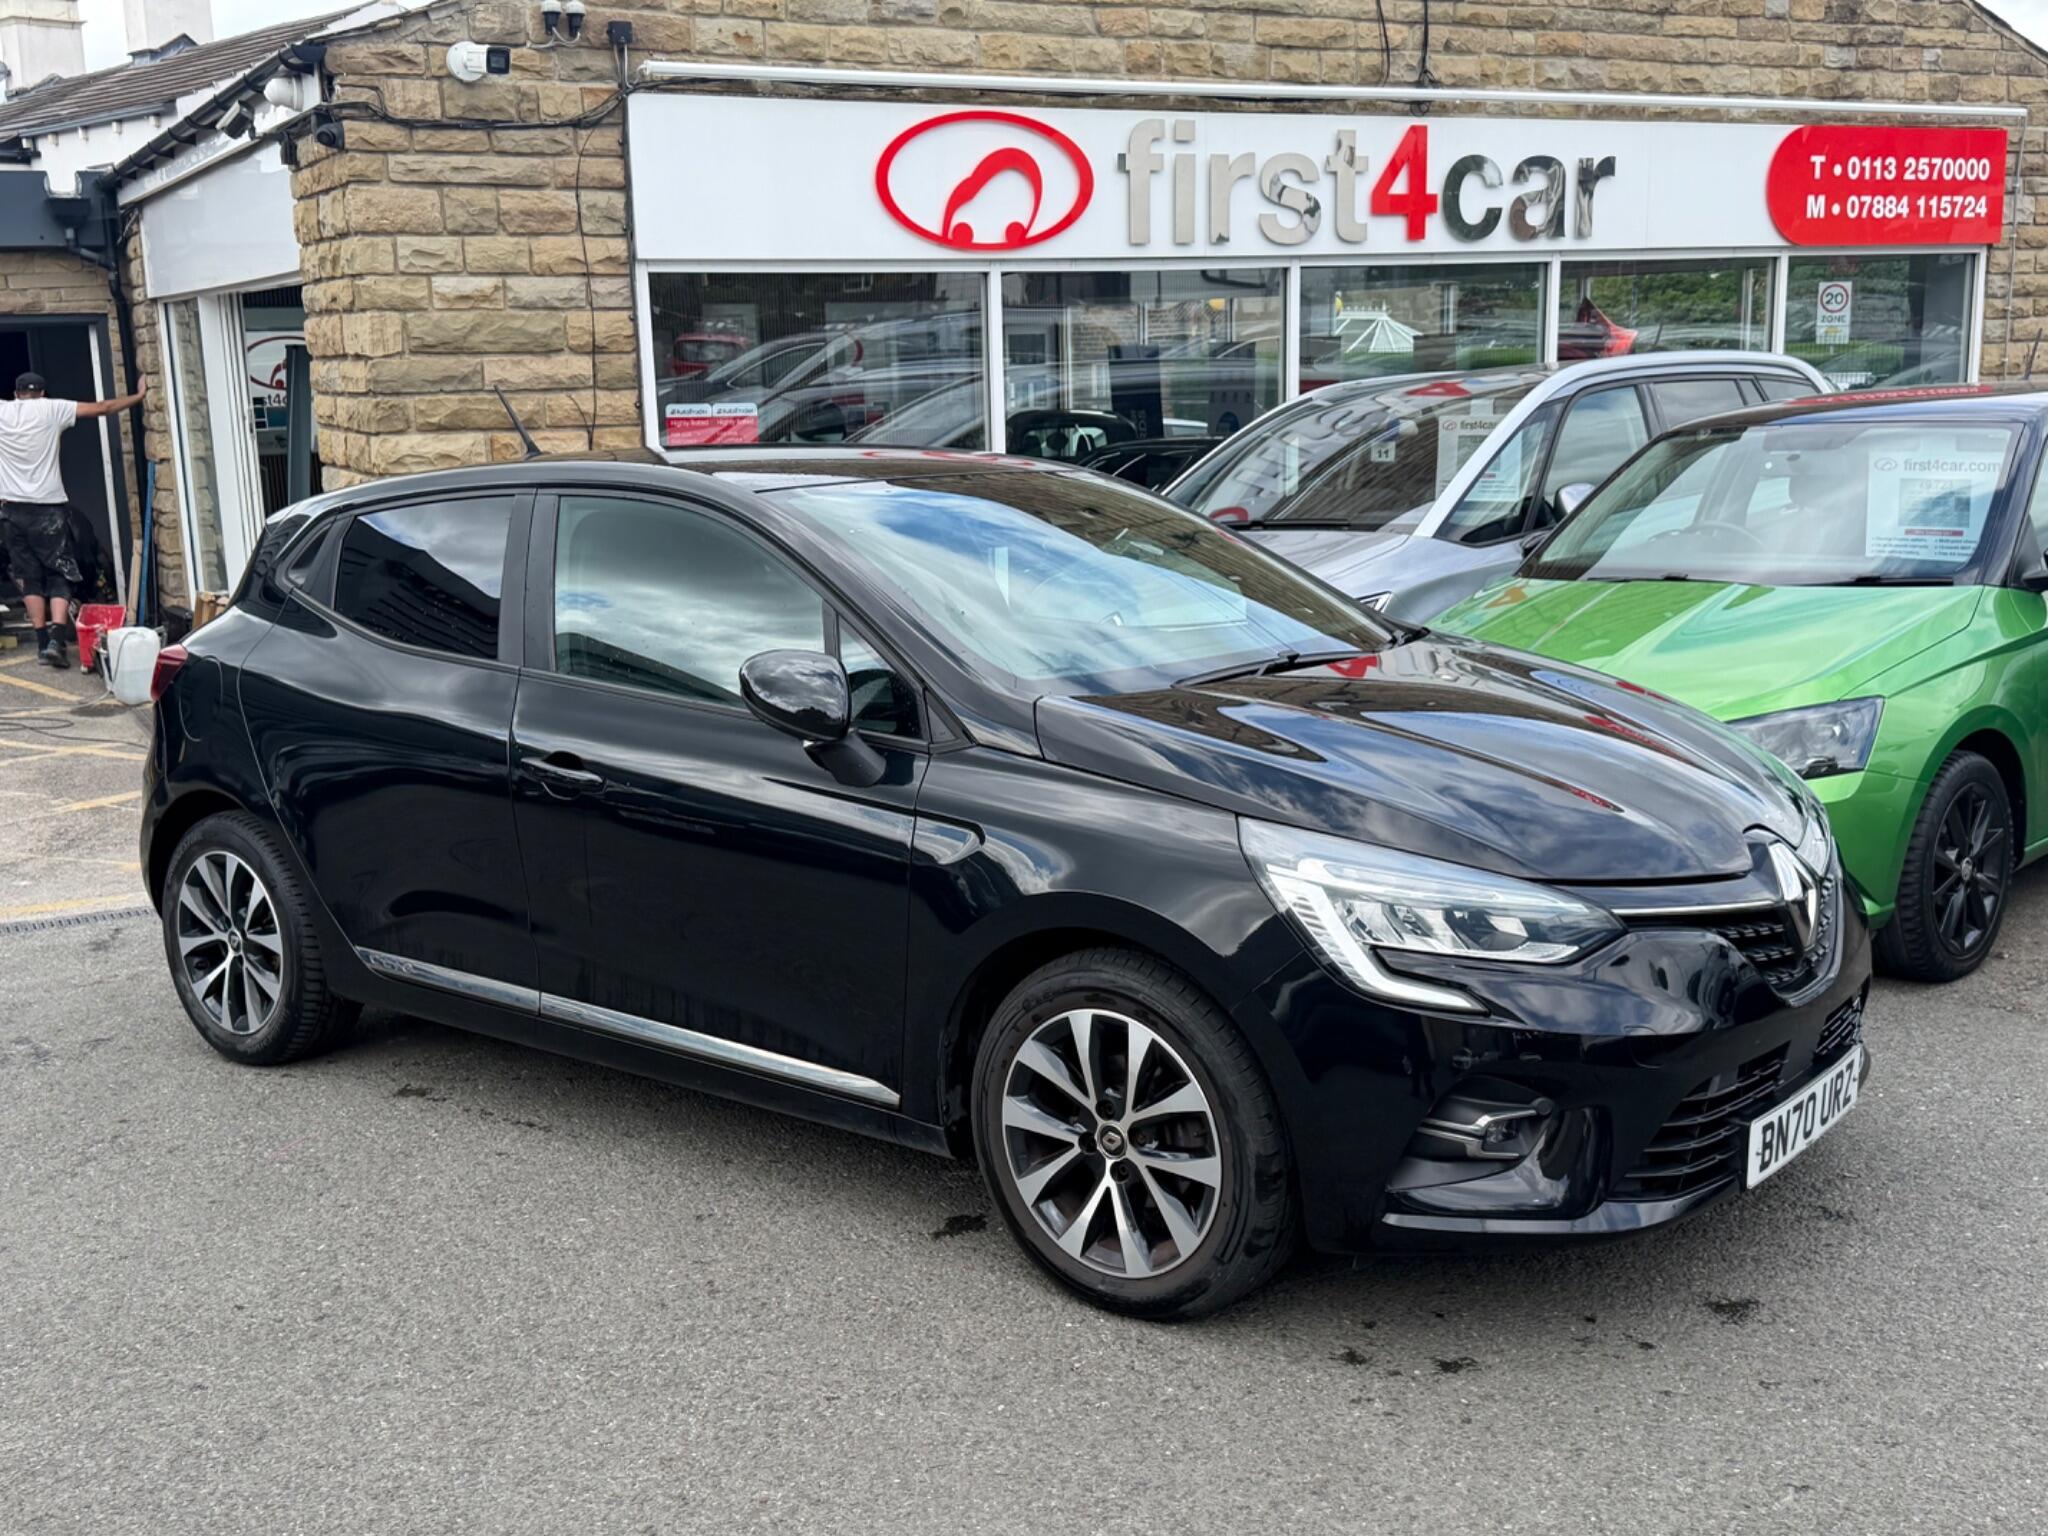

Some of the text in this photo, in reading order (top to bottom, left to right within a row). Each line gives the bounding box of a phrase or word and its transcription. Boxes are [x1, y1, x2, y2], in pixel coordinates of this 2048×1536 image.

[1810, 155, 1990, 181] T 0113 2570000
[1117, 118, 1616, 246] first4car
[1806, 194, 1988, 219] M 07884 115724
[1825, 292, 1844, 305] 20
[1820, 314, 1847, 324] ZONE
[1759, 1058, 1855, 1173] BN70 URZ
